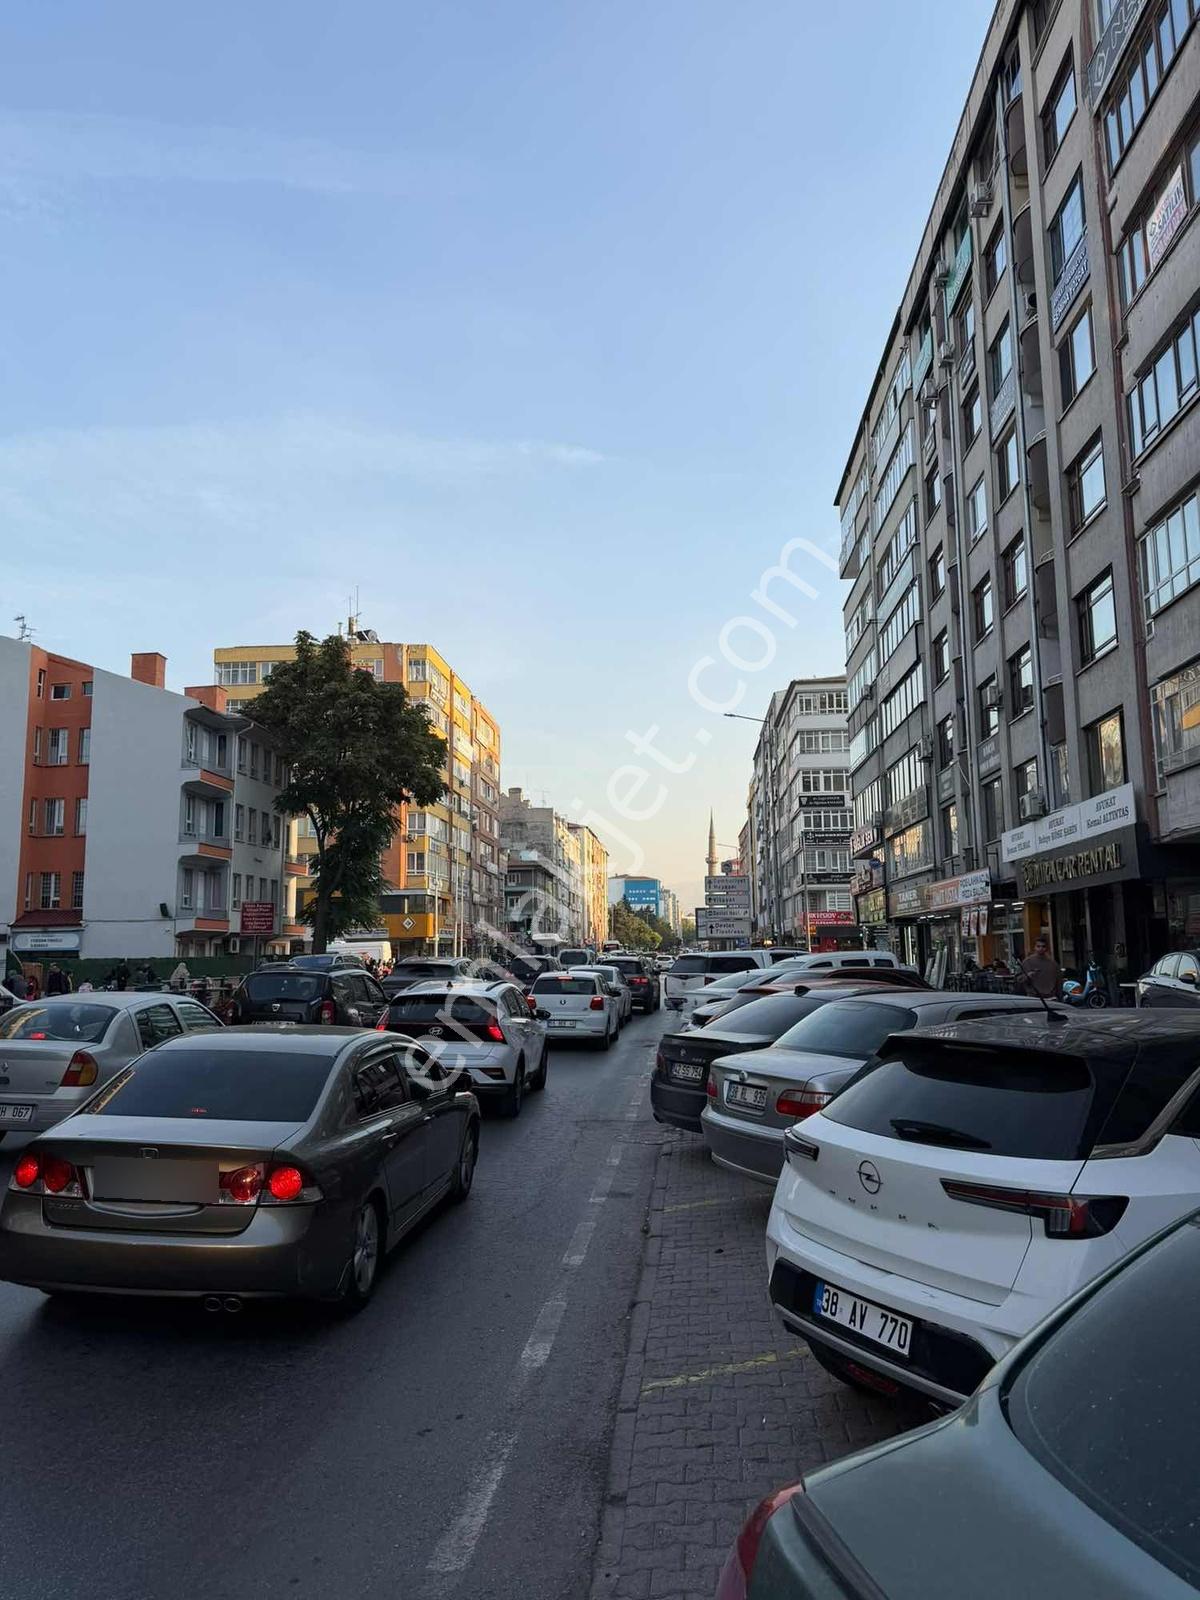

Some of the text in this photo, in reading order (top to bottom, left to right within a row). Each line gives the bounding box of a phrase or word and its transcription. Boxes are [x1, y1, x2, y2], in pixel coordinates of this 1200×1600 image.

[1079, 843, 1121, 876] RENTAL
[12, 1107, 30, 1117] 067
[822, 1288, 909, 1350] 38 AV 770
